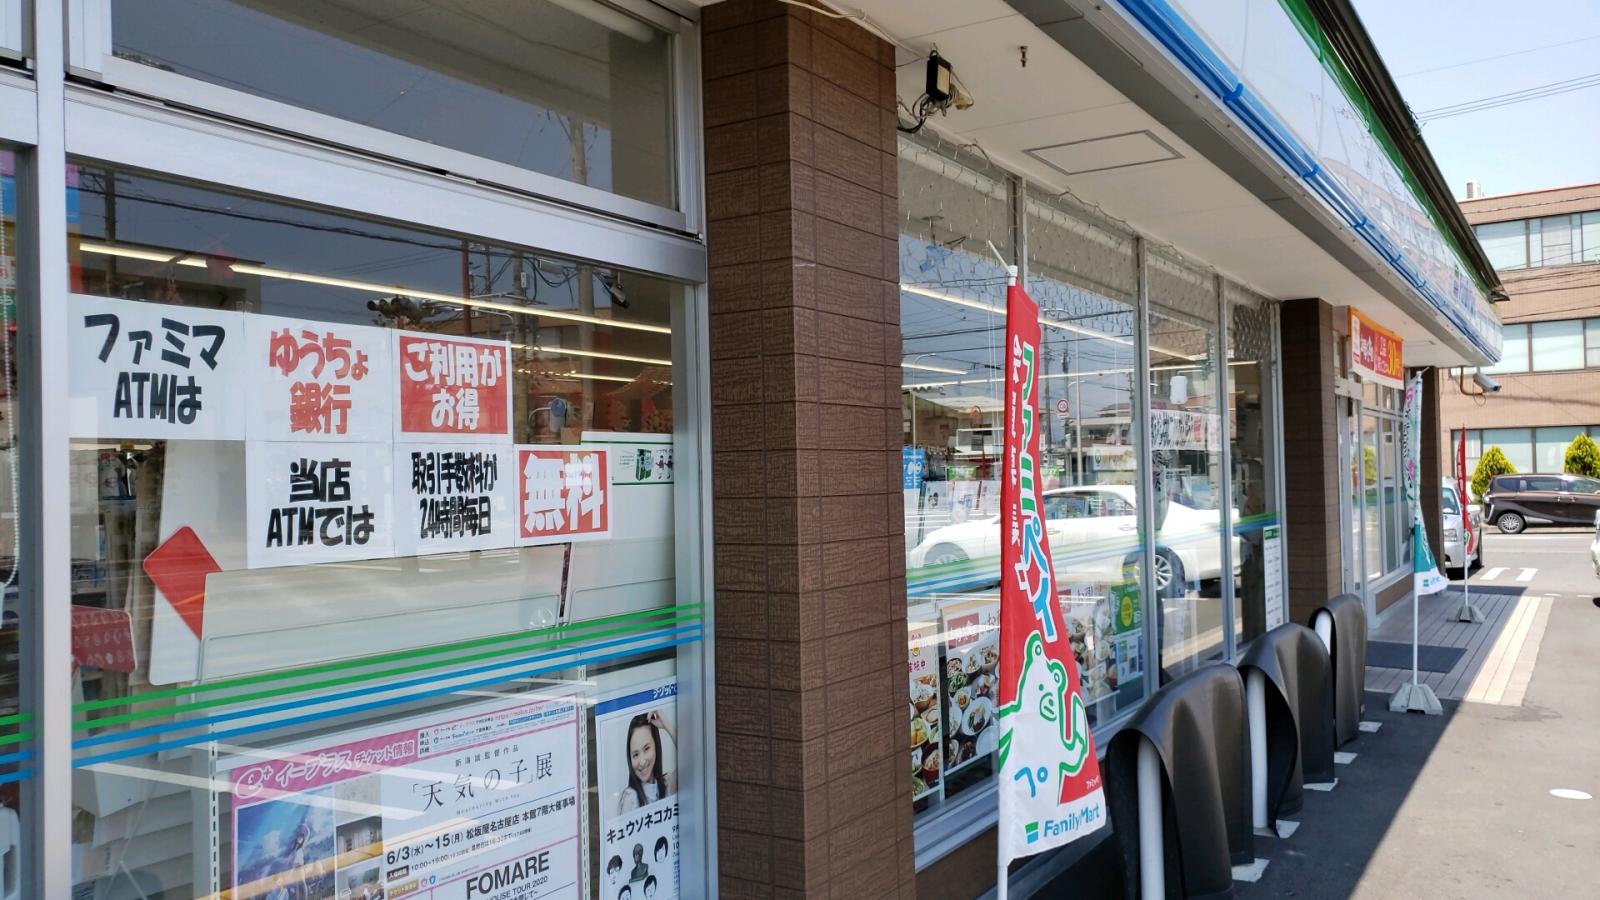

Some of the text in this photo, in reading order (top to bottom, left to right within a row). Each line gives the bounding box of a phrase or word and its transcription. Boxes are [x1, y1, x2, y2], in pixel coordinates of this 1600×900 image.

[84, 313, 226, 370] ファミマ
[269, 328, 368, 380] ゆうちょ
[404, 342, 502, 387] ご利用が
[113, 372, 202, 425] ATMは
[289, 381, 352, 434] 銀行
[431, 389, 480, 430] お得
[289, 458, 351, 503] 当店
[411, 452, 498, 494] 取引手数料が
[523, 453, 603, 533] 無料
[266, 505, 374, 548] ATMでは
[419, 496, 491, 539] 24時間毎日
[275, 750, 351, 788] イープラス
[354, 740, 414, 768] チケット情報
[466, 851, 549, 900] FOMARE
[512, 883, 531, 895] TOUR
[532, 876, 548, 888] 2020
